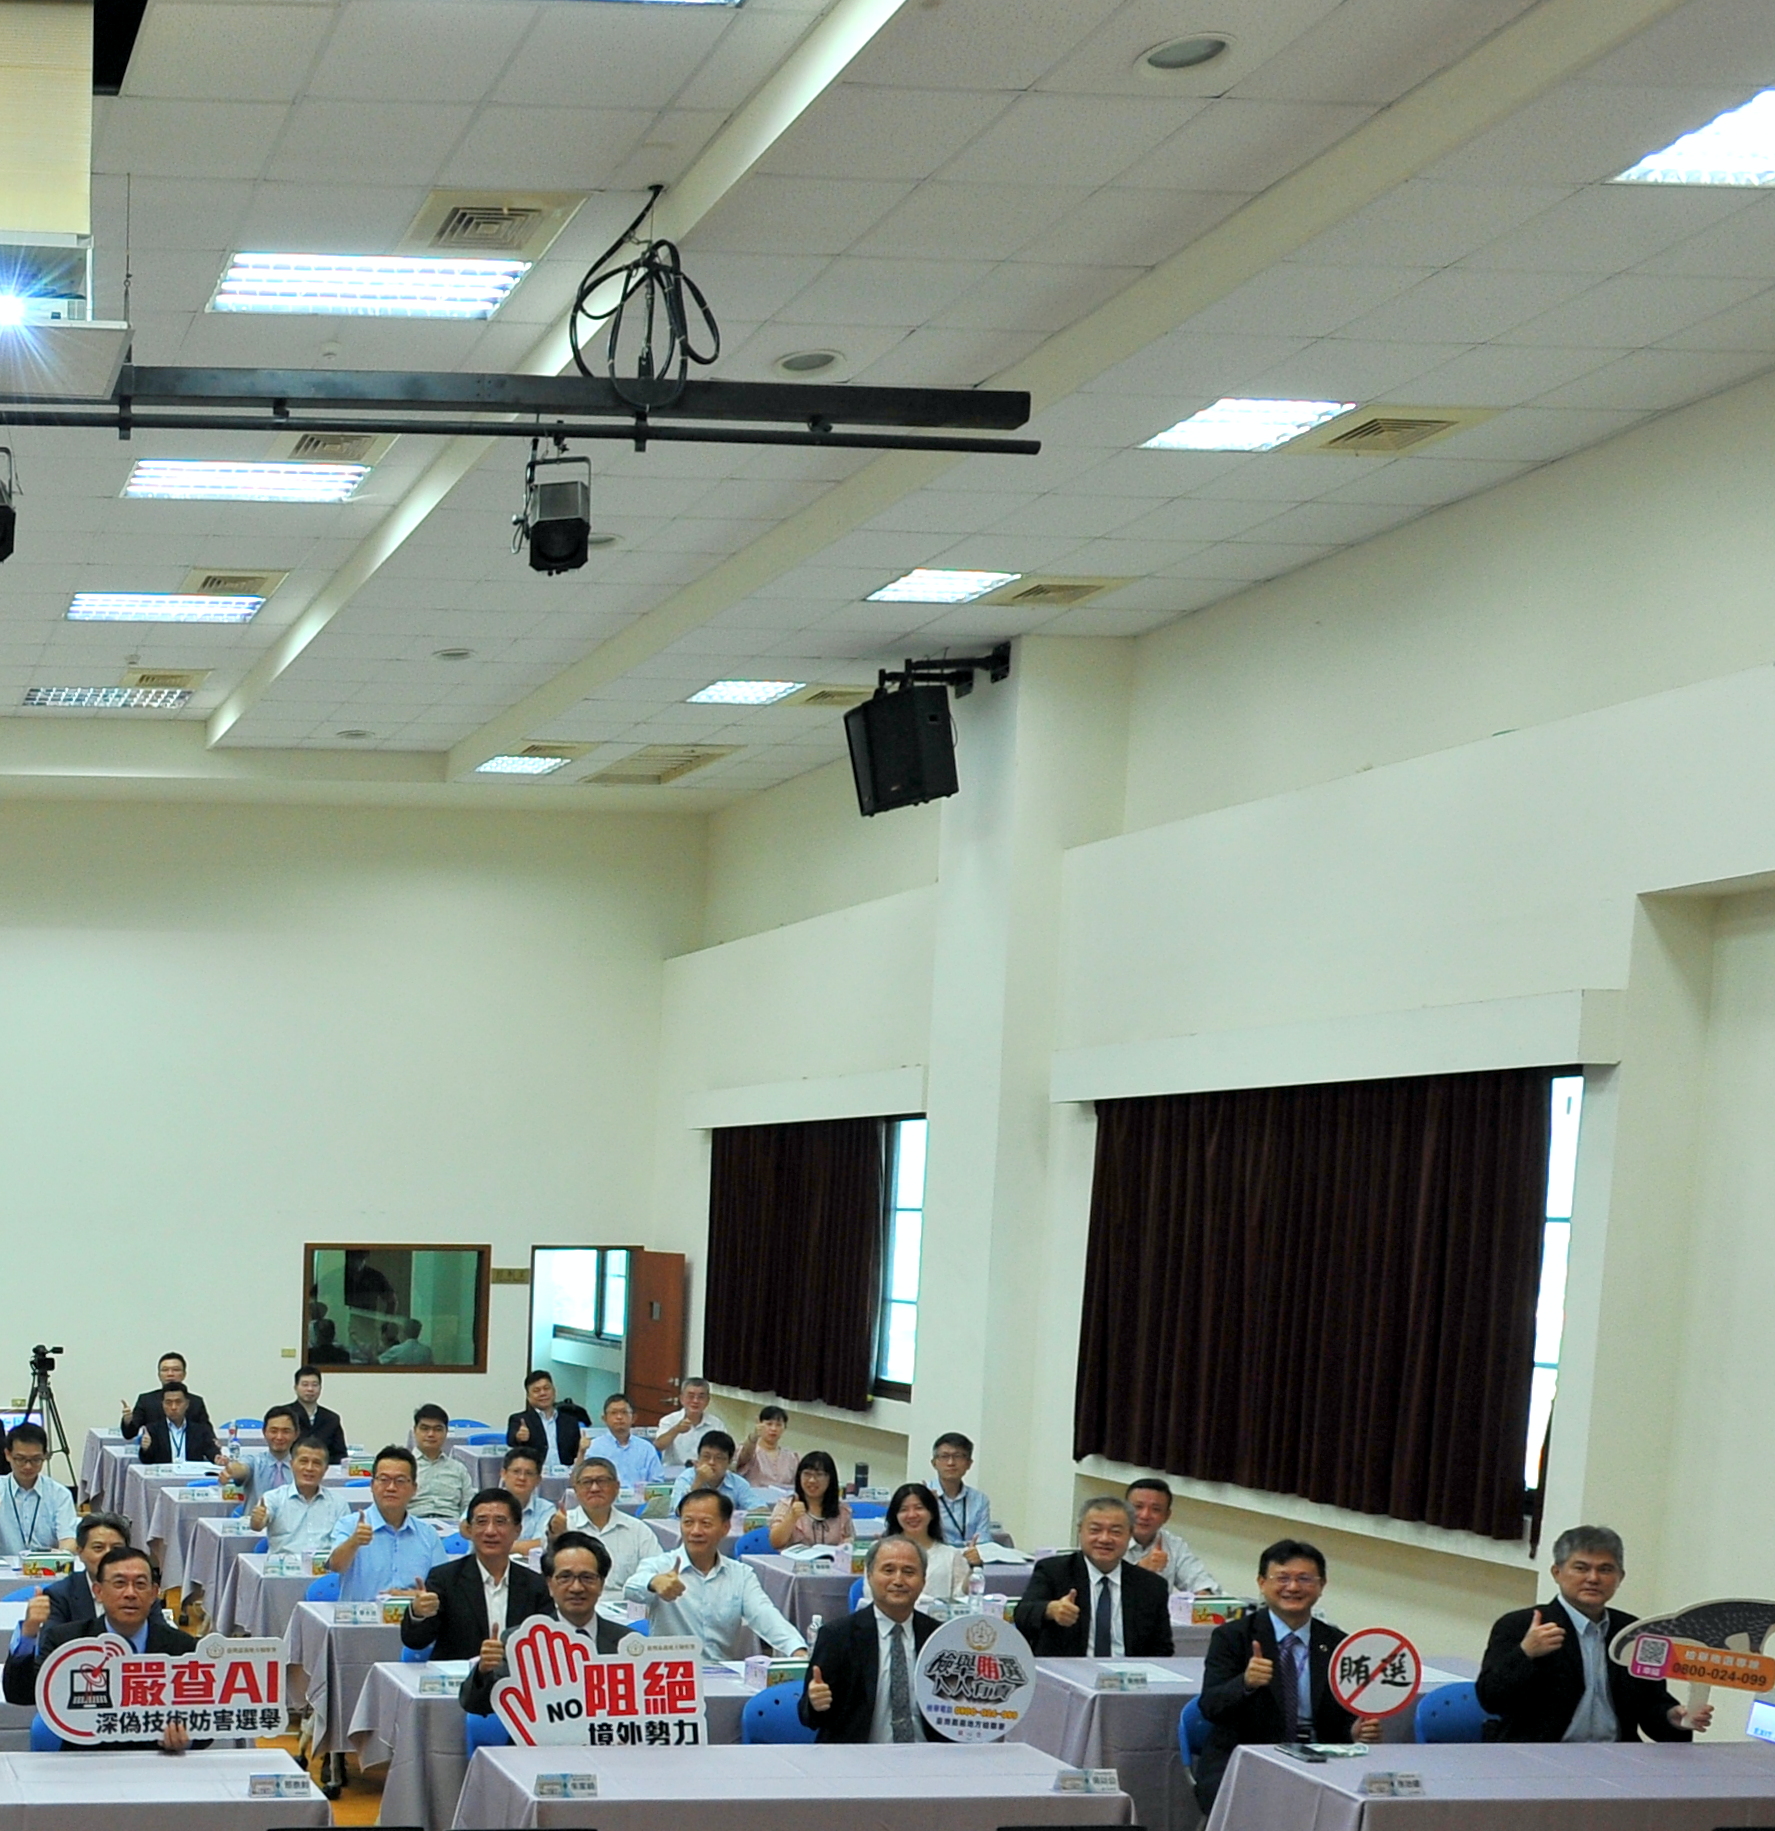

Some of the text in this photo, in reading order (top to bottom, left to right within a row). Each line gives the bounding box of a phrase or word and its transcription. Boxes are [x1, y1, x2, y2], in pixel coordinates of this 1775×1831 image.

[120, 1660, 279, 1707] 嚴查AI
[1339, 1653, 1412, 1687] 賄選
[1672, 1662, 1767, 1686] 0800-024-099
[584, 1661, 698, 1717] 阻絕
[95, 1708, 281, 1734] 深偽技術妨害選舉
[546, 1699, 583, 1723] NO
[588, 1719, 699, 1746] 境外勢力
